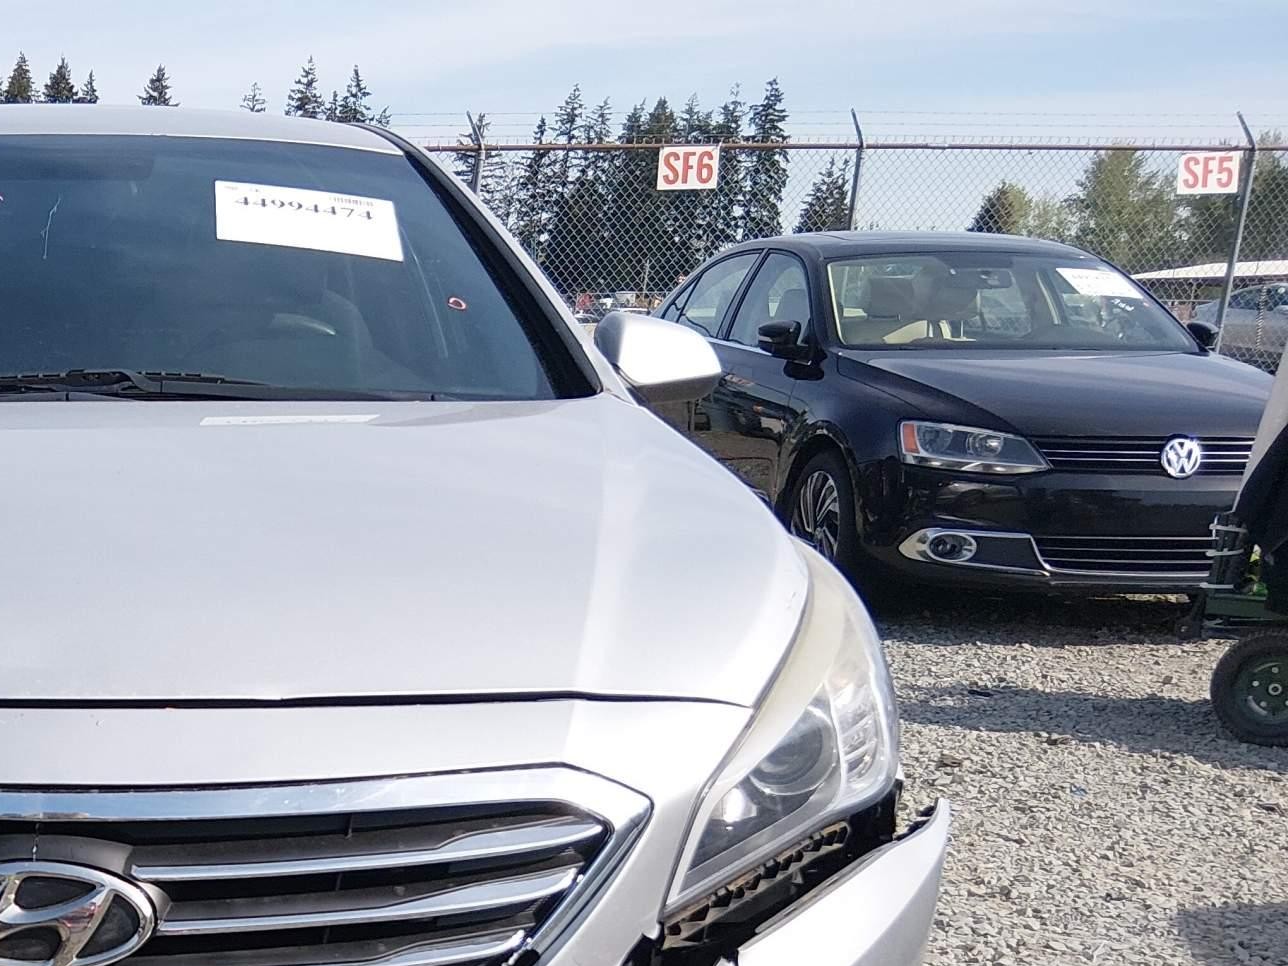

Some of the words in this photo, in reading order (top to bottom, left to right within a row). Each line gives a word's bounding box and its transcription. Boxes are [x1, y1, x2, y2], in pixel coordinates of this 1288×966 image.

[662, 151, 714, 187] SF6
[1183, 156, 1234, 188] SF5
[234, 195, 374, 221] 44994474
